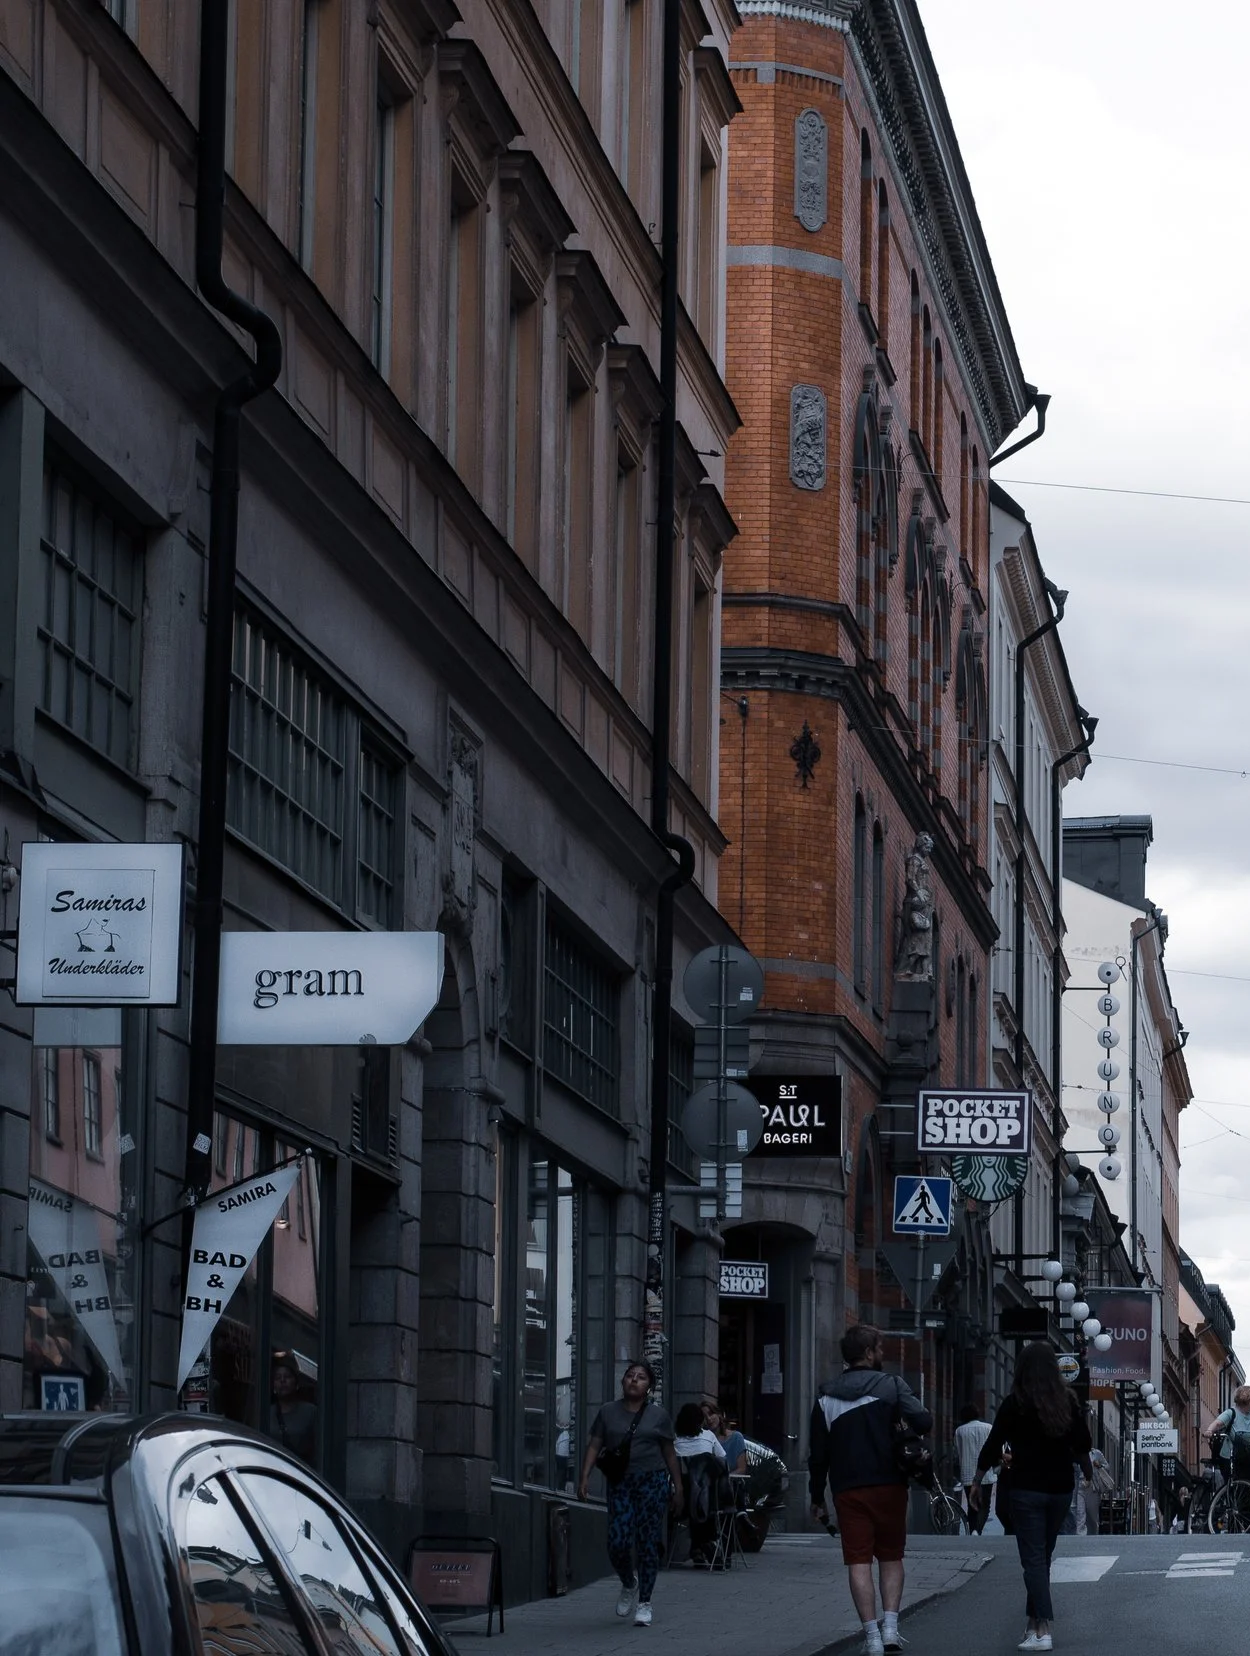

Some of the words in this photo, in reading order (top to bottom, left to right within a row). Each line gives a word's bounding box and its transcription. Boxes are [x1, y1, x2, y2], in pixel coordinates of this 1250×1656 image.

[51, 890, 147, 913] Samiras
[48, 957, 145, 977] Underkläder
[253, 967, 365, 1008] gram
[1103, 998, 1114, 1142] BRUNO
[926, 1098, 1021, 1119] POCKET
[763, 1133, 813, 1144] BAGERI
[925, 1117, 1021, 1145] SHOP
[217, 1181, 277, 1213] SAMIRA
[193, 1250, 247, 1269] BAD
[720, 1265, 765, 1278] POCKET
[206, 1273, 225, 1289] &
[720, 1276, 766, 1294] SHOP
[186, 1296, 222, 1314] BH
[1105, 1327, 1148, 1342] RUNO
[1091, 1379, 1115, 1387] HOPE
[1141, 1441, 1173, 1449] pantbank
